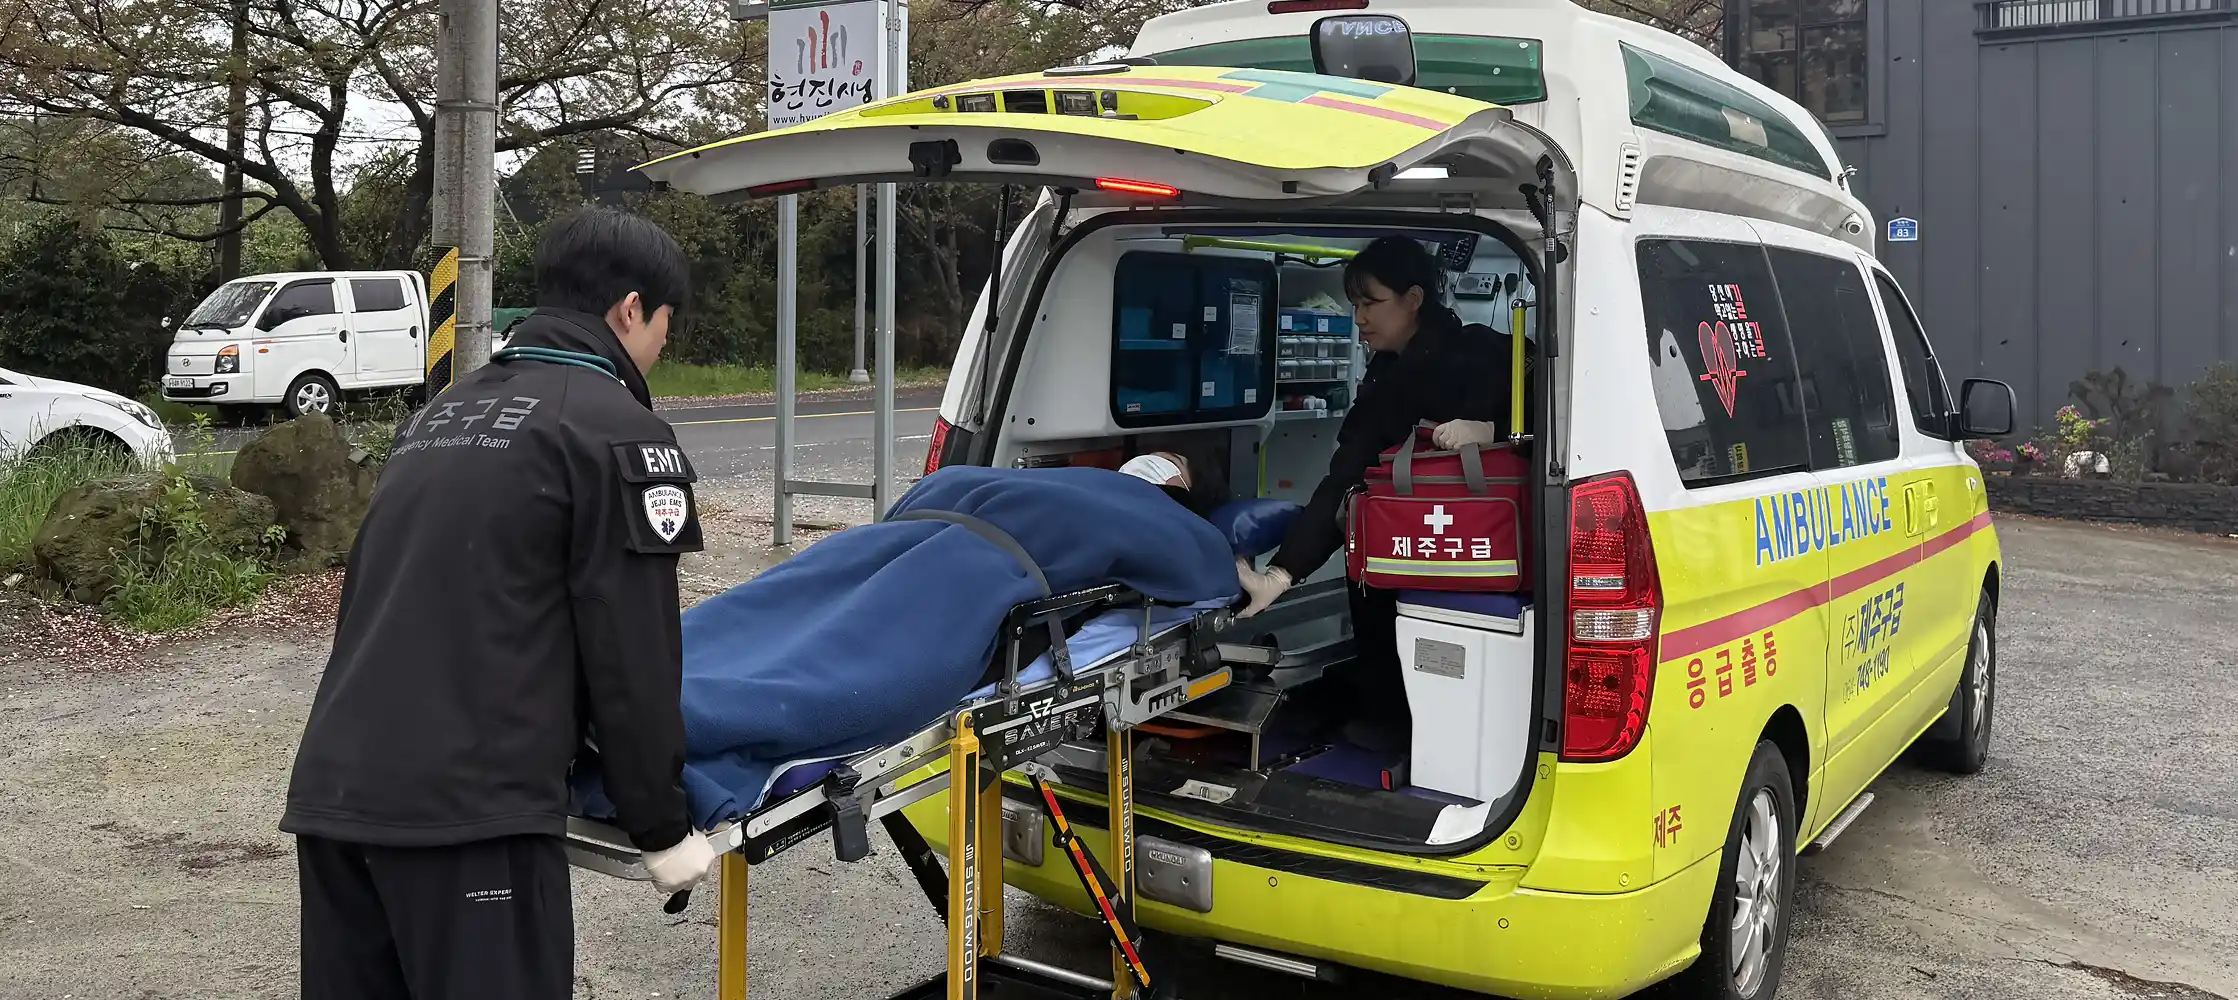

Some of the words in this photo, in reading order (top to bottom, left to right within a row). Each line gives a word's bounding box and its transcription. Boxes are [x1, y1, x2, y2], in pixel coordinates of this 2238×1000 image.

[1897, 229, 1909, 237] 83
[432, 434, 476, 448] Medical
[476, 434, 511, 449] Team
[642, 447, 682, 473] EMT
[648, 489, 682, 499] AMBULANCE
[650, 499, 666, 508] JEJU
[669, 498, 682, 507] EMS
[1755, 477, 1892, 566] AMBULANCE
[1391, 536, 1492, 559] 제주구급
[1686, 630, 1777, 710] 응급출동
[1030, 697, 1054, 719] EZ
[1005, 711, 1079, 746] SAVER
[1122, 776, 1131, 873] SUNGWOO
[1654, 804, 1682, 848] 제주
[964, 865, 974, 983] SUNGWOO
